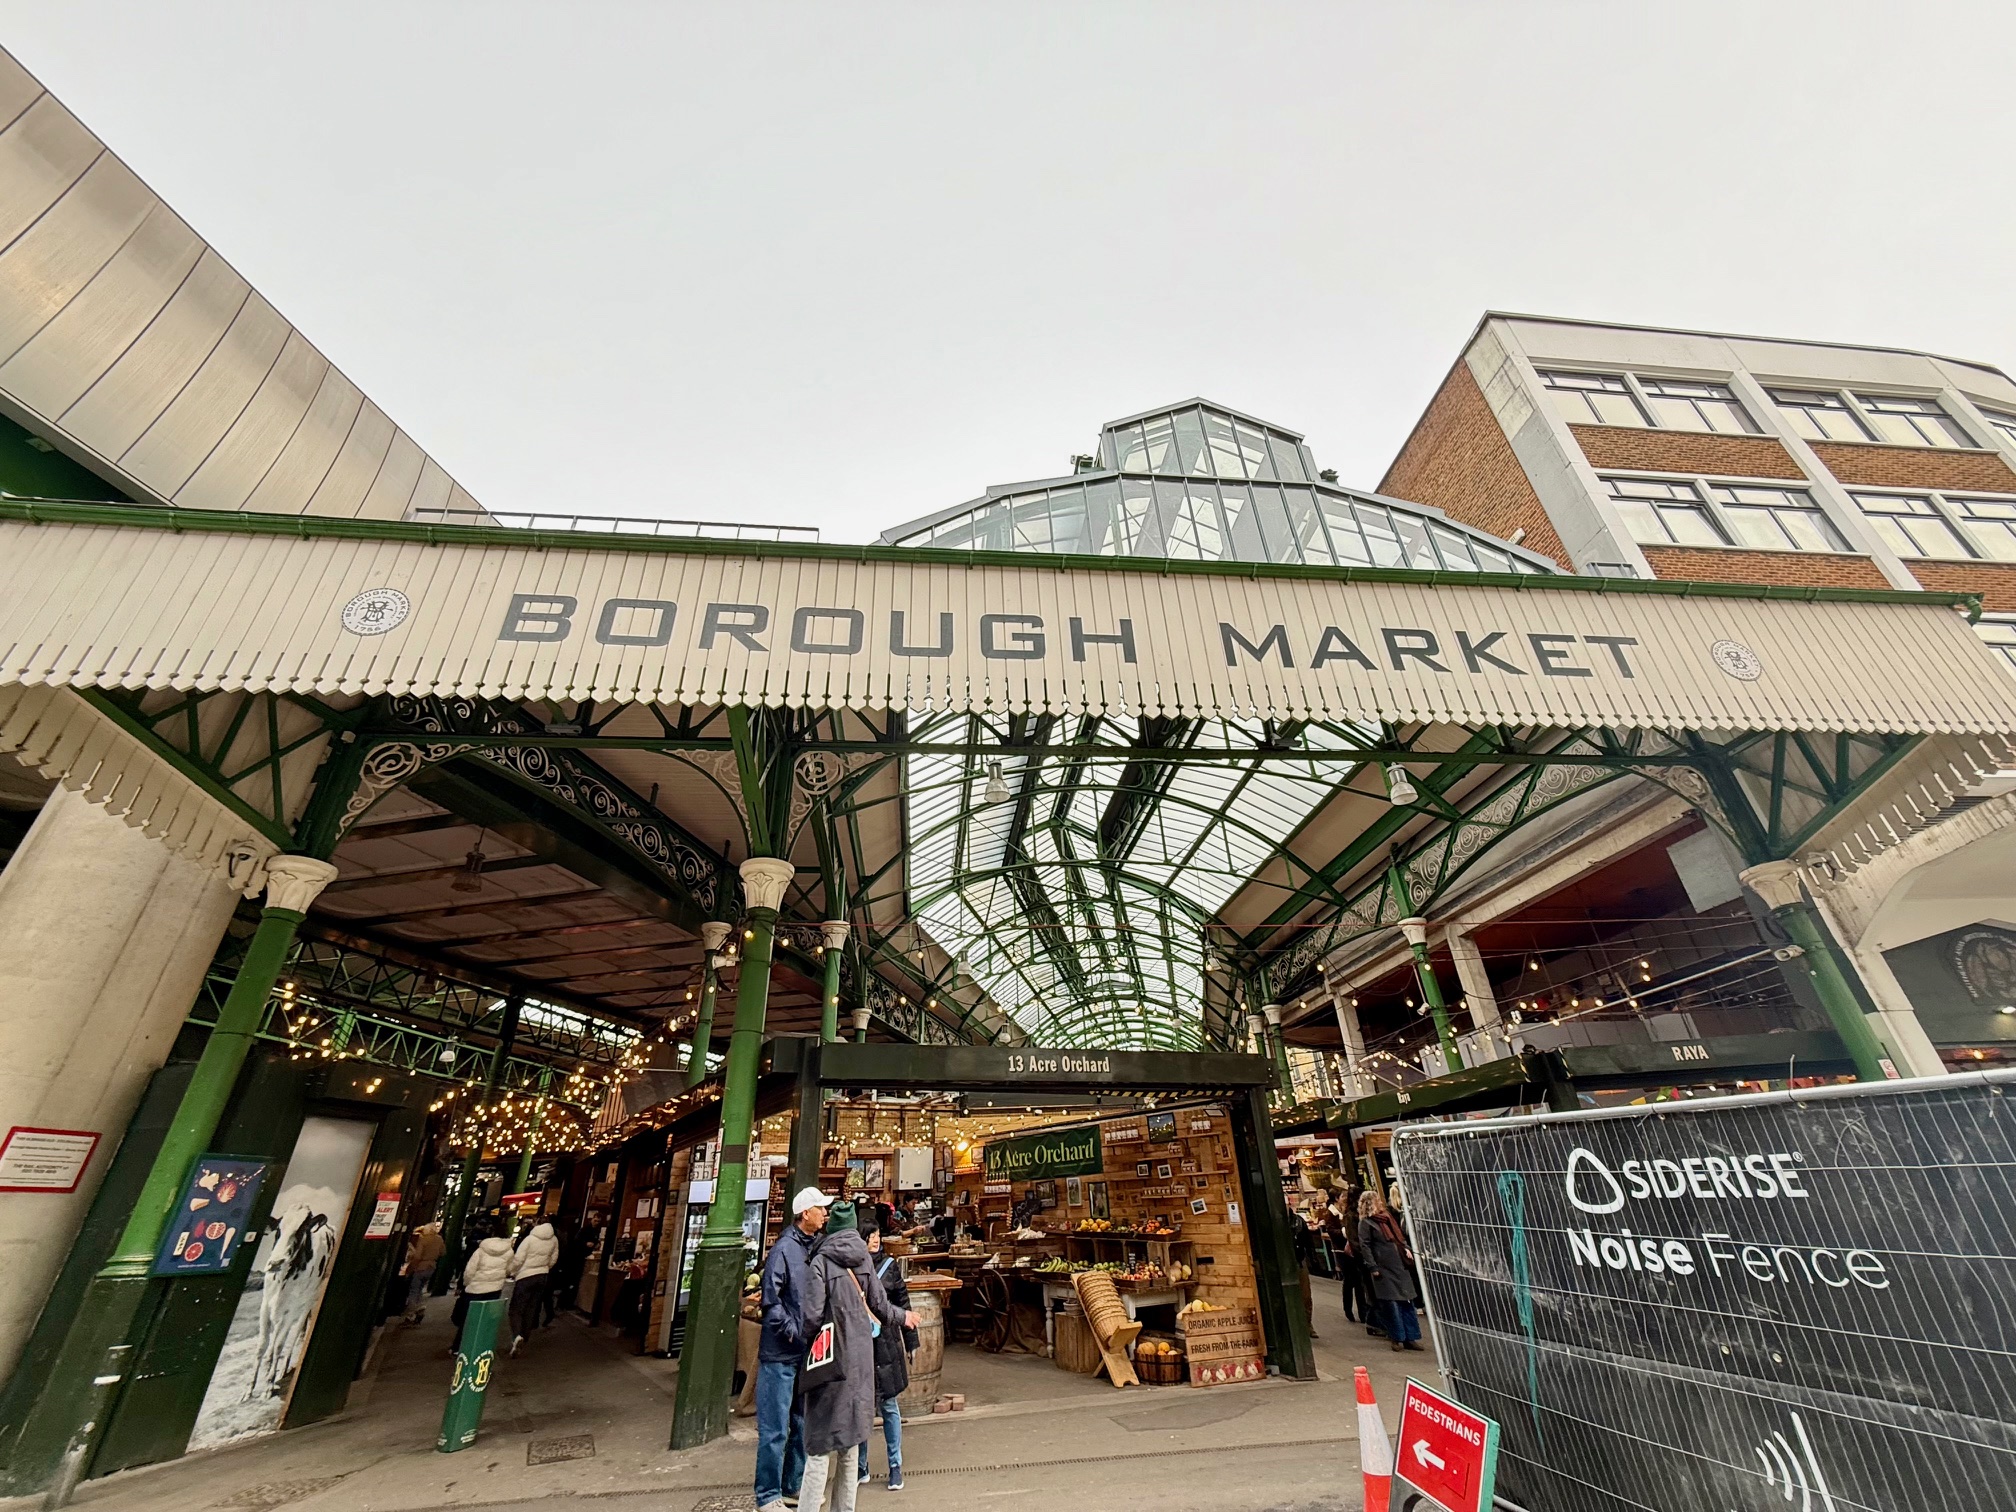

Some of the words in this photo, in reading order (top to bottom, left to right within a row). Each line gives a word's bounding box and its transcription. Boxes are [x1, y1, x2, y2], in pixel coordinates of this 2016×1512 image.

[345, 590, 388, 618] BOROUGH
[391, 592, 407, 620] MARKET
[354, 624, 381, 632] 1756
[498, 593, 1137, 663] BOROUGH
[1218, 621, 1639, 679] MARKET
[1008, 1055, 1024, 1072] 13
[1029, 1055, 1057, 1072] Acre
[1061, 1055, 1110, 1072] Orchard
[1671, 1045, 1709, 1061] RAYA
[989, 1150, 1001, 1169] 13
[1003, 1150, 1032, 1168] Acre
[1034, 1138, 1095, 1165] Orchard
[1567, 1228, 1694, 1276] Noise
[1701, 1233, 1890, 1289] Fence
[1188, 1319, 1217, 1330] ORGANIC
[1217, 1317, 1237, 1328] APPLE
[1190, 1343, 1211, 1355] FRESH
[1211, 1341, 1230, 1352] FROM
[1230, 1340, 1242, 1350] THE
[1408, 1396, 1481, 1447] PEDESTRIANS
